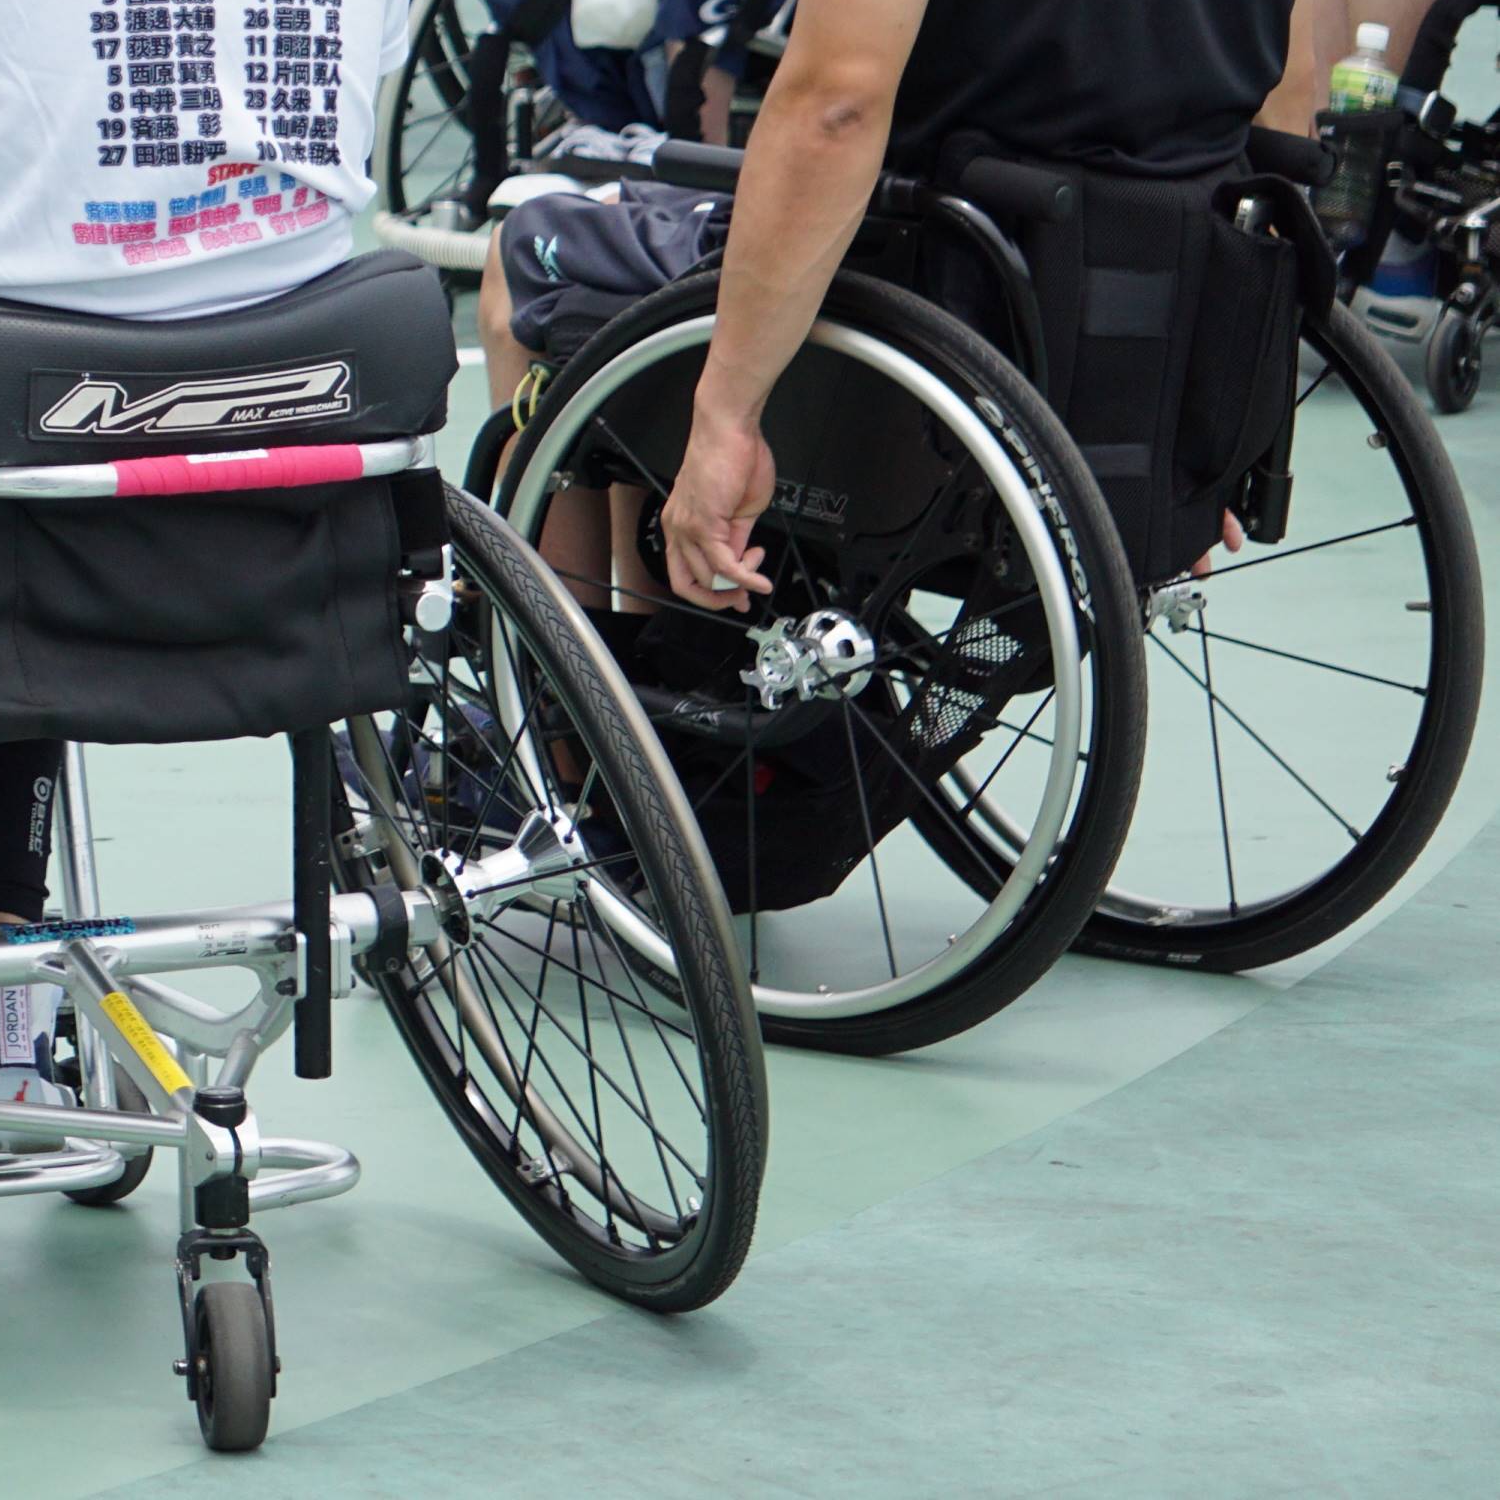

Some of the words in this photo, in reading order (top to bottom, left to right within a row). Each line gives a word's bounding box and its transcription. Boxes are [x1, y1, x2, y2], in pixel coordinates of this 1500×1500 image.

[90, 11, 120, 33] 33
[243, 8, 270, 30] 26
[92, 38, 121, 60] 17
[244, 35, 267, 57] 11
[107, 64, 123, 86] 5
[243, 62, 268, 84] 12
[108, 91, 124, 113] 8
[243, 89, 267, 111] 23
[97, 118, 126, 140] 19
[98, 144, 127, 167] 27
[231, 406, 265, 422] MAX
[5, 989, 21, 1048] JORDAN
